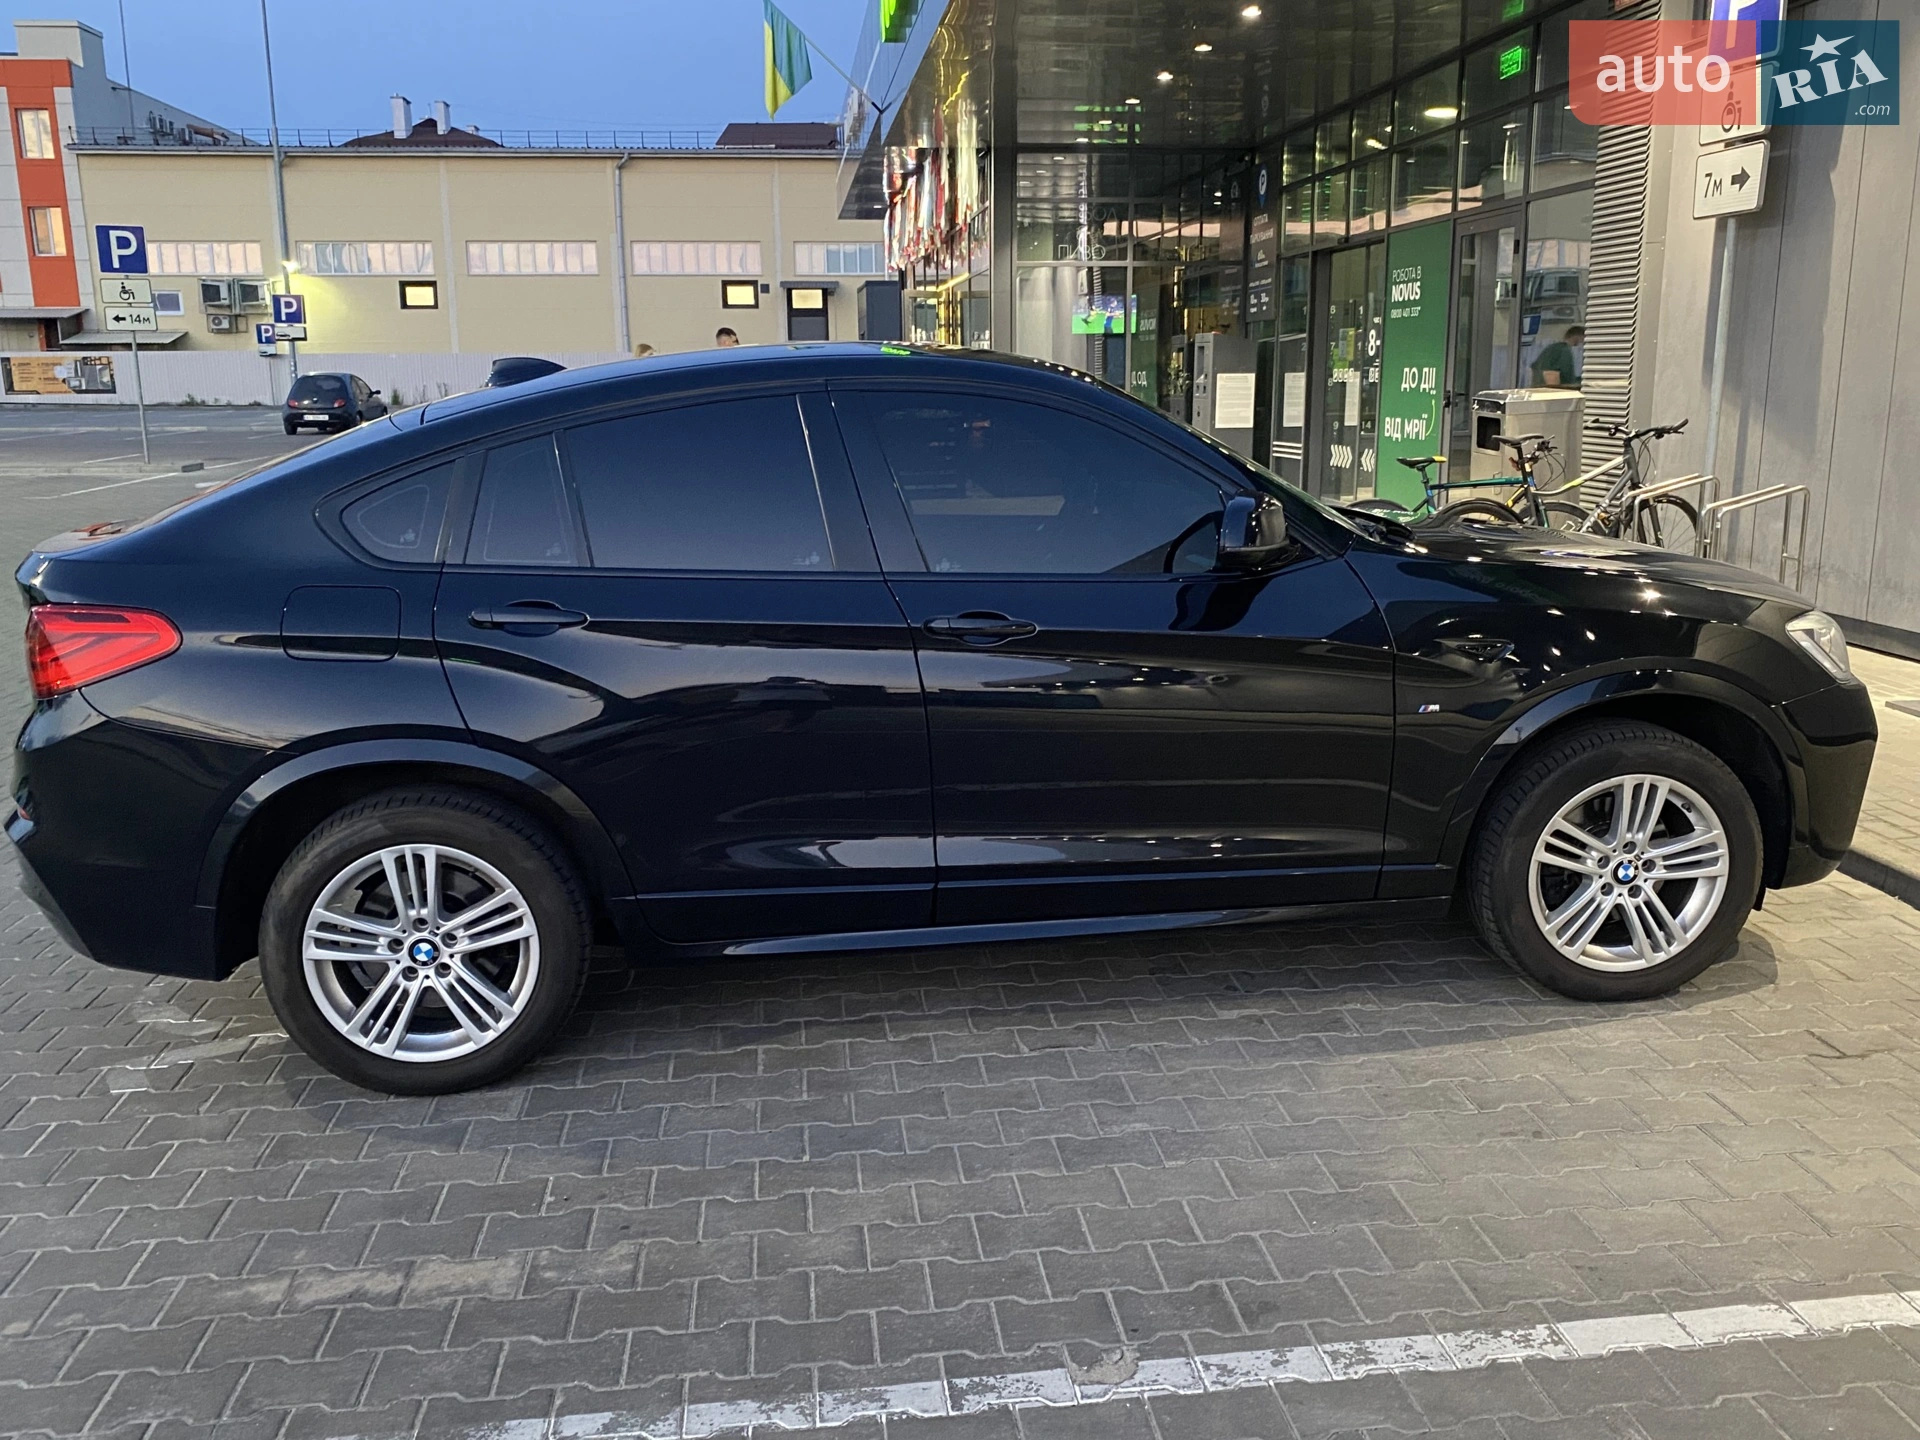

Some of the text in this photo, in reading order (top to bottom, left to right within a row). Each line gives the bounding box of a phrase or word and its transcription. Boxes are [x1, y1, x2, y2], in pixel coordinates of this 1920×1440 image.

[109, 229, 138, 269] P
[1392, 266, 1416, 282] РОБОТА
[1391, 280, 1421, 303] NOVUS
[128, 313, 151, 324] 14м
[280, 297, 298, 321] P
[260, 325, 273, 343] P
[1401, 367, 1419, 392] ДО
[1384, 413, 1428, 442] ВІД МРІЇ
